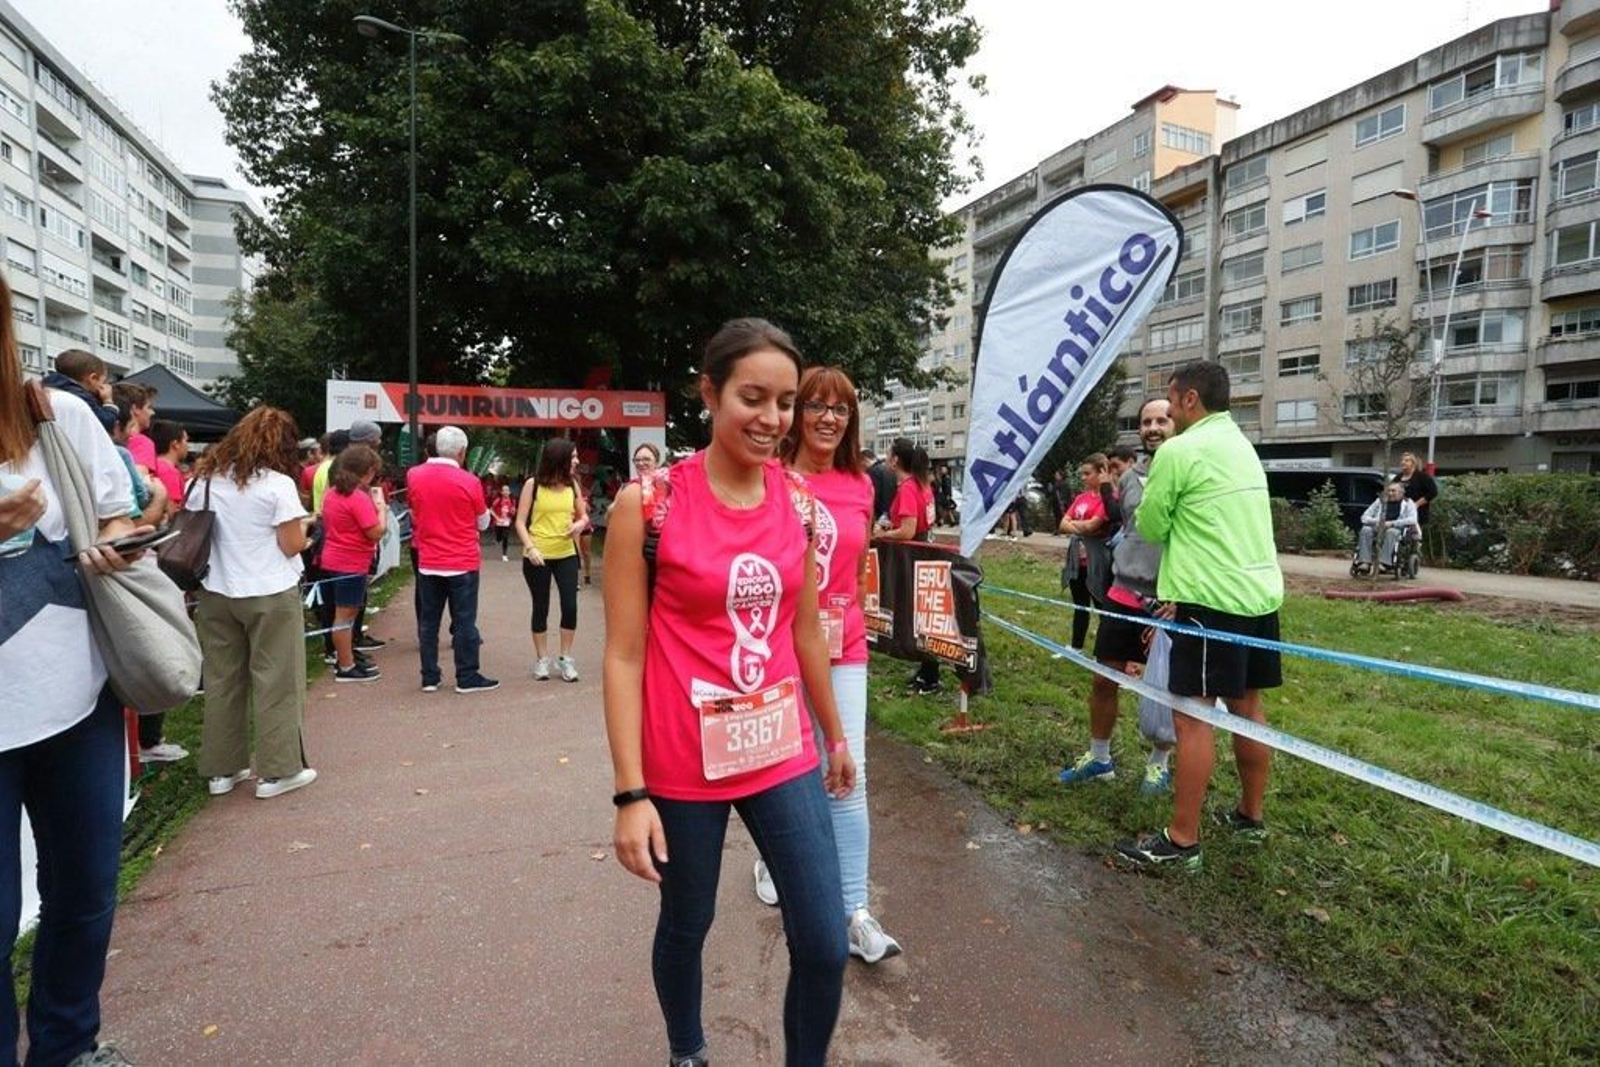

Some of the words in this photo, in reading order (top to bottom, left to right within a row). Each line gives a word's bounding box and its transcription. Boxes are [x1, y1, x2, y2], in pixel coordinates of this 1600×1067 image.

[969, 232, 1157, 513] Atlántico
[918, 566, 950, 588] SAV
[737, 583, 774, 597] VIGO
[918, 589, 946, 611] THE
[726, 709, 783, 752] 3367
